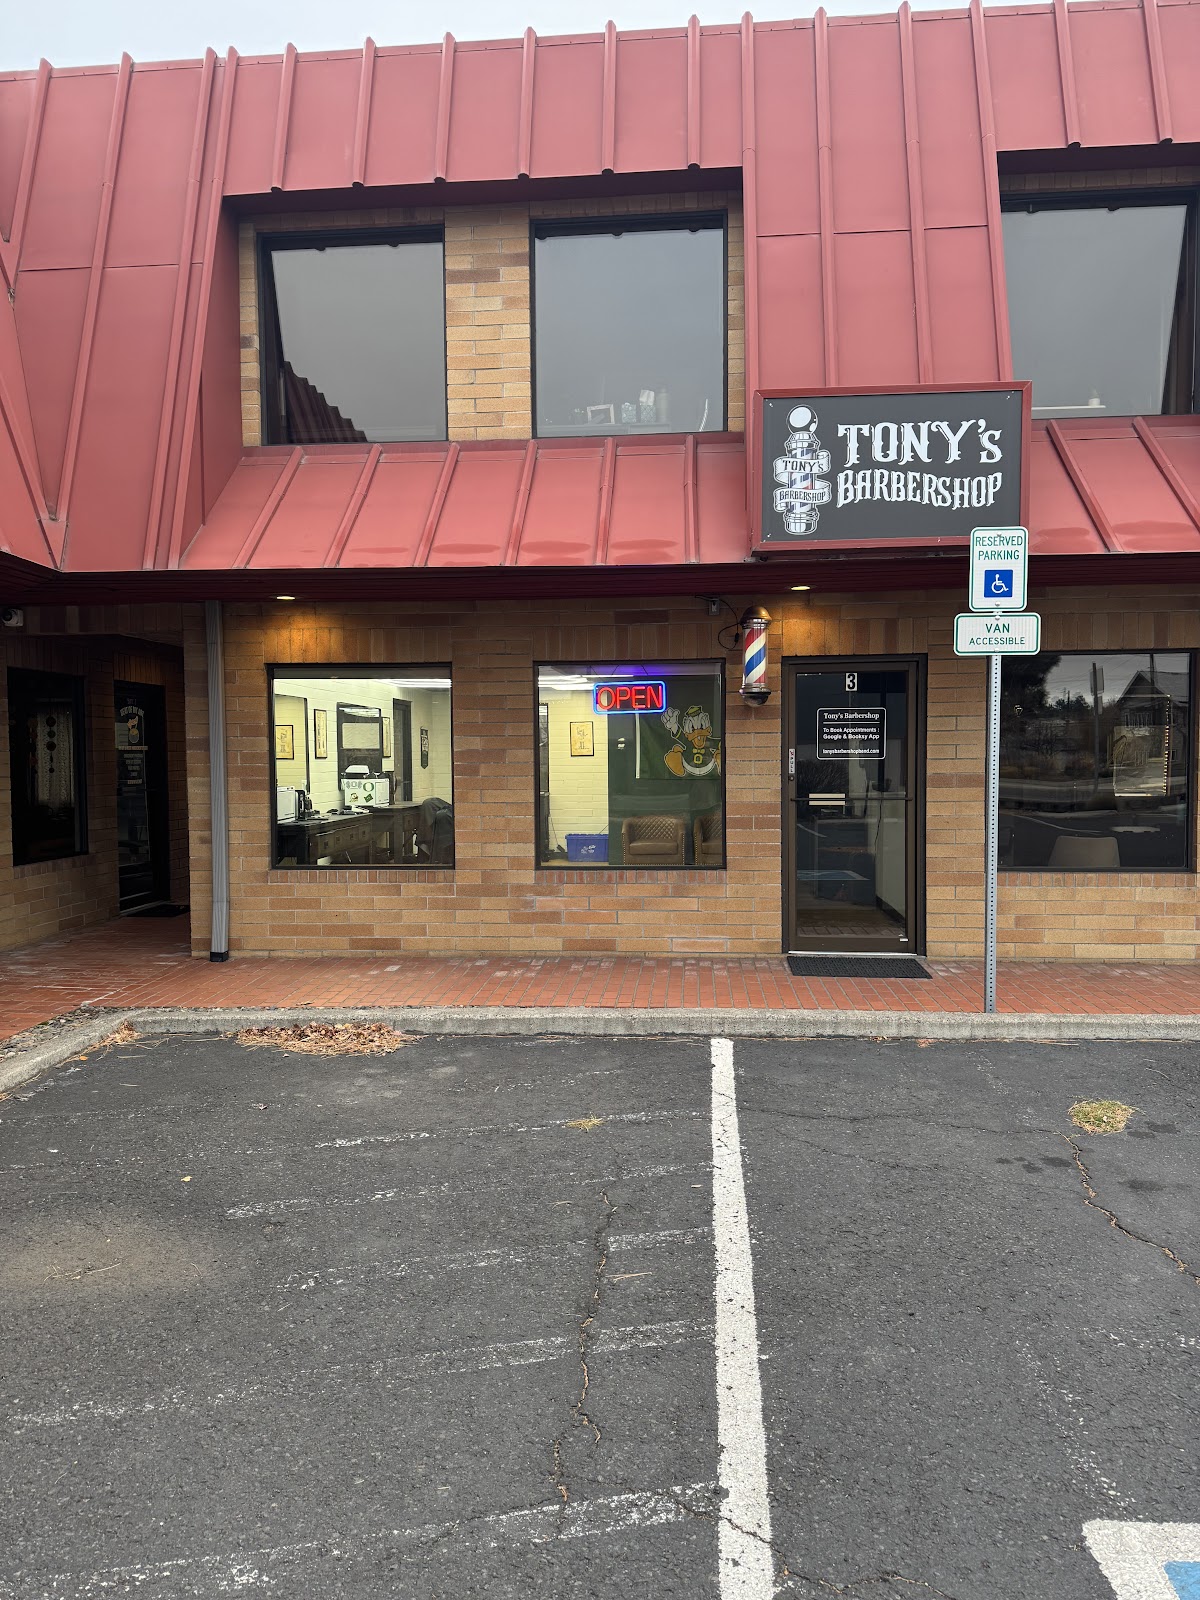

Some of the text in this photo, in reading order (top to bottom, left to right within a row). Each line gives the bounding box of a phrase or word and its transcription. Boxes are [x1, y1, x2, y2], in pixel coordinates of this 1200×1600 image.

[836, 468, 1003, 510] BARBERSHOP
[780, 490, 826, 502] BARBERSHOP
[975, 535, 1023, 547] RESERVED
[978, 549, 1020, 561] PARKING
[985, 623, 1010, 634] VAN
[968, 636, 1026, 646] ACCESSIBLE
[847, 673, 856, 689] 3
[597, 685, 662, 710] OPEN
[823, 712, 880, 720] Tony's Barbershop
